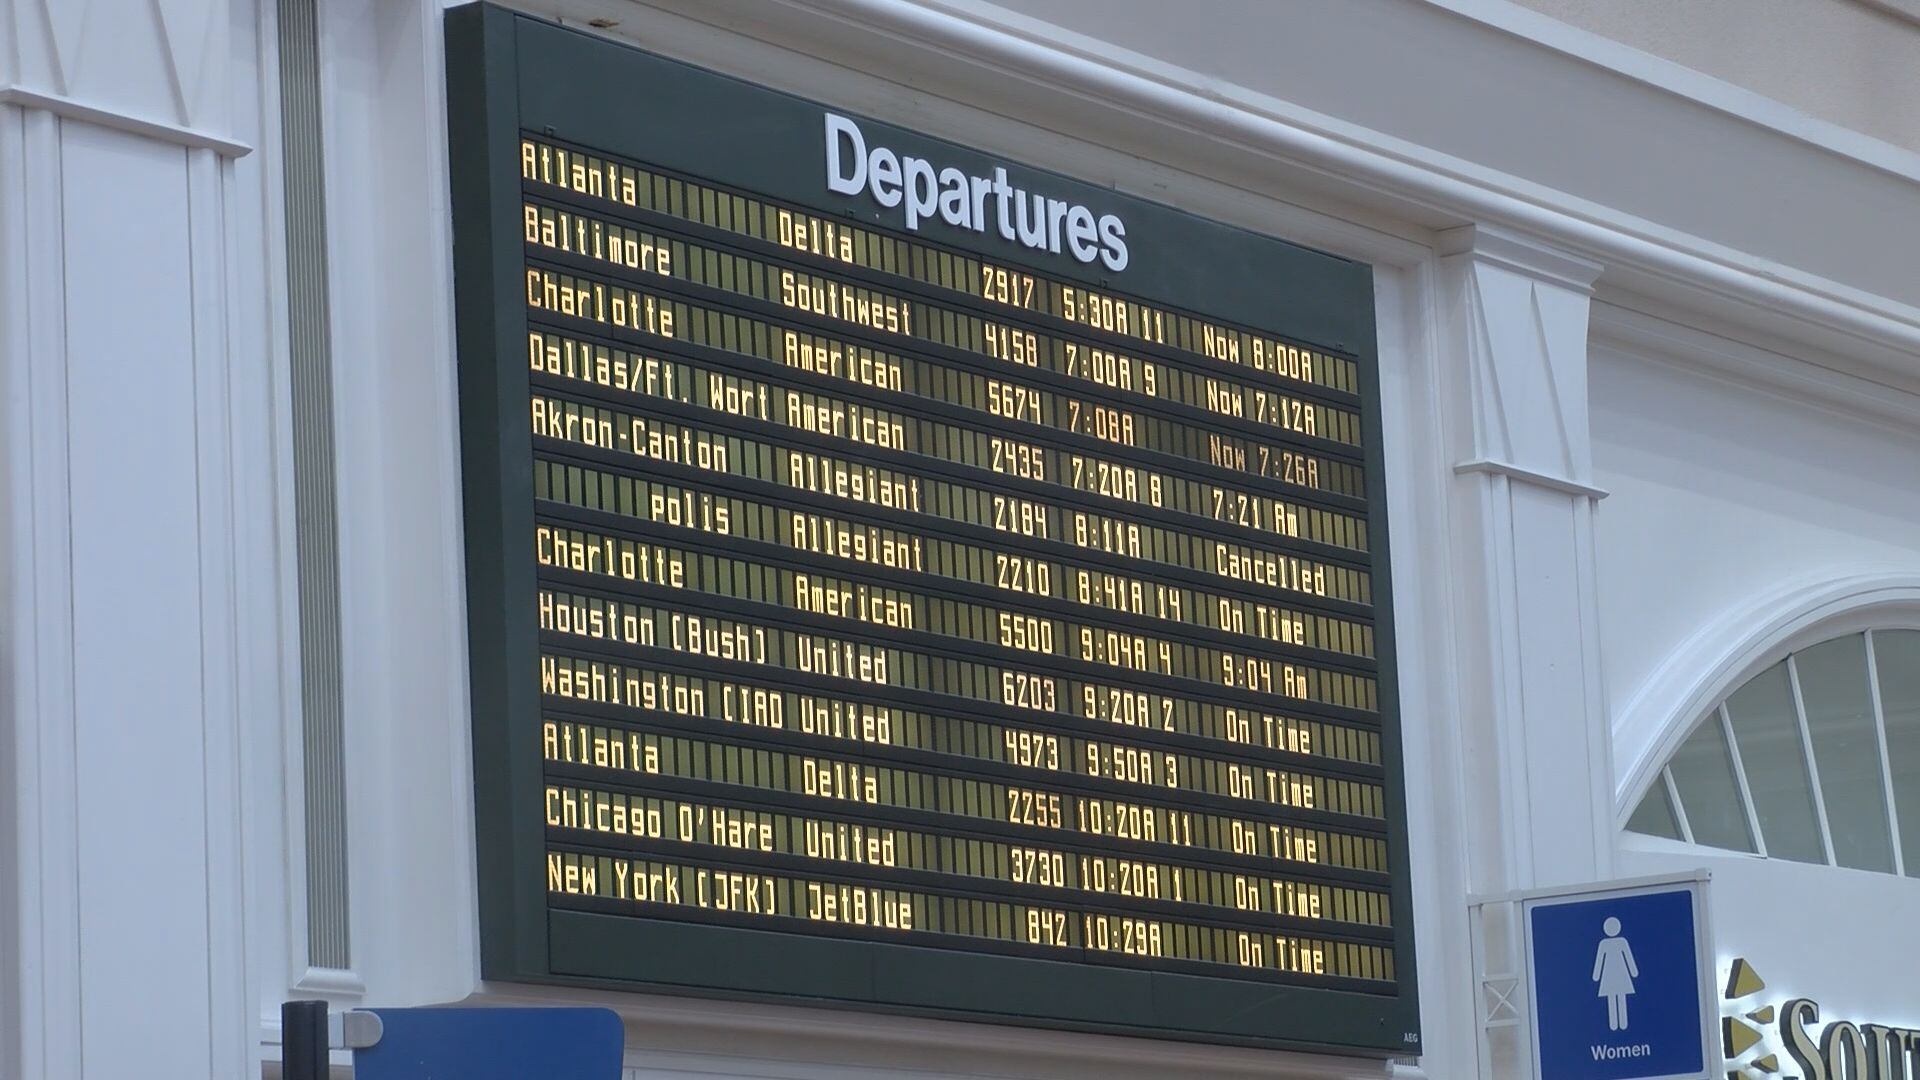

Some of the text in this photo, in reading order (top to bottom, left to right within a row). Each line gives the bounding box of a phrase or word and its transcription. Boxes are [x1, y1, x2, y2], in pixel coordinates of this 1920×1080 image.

[521, 142, 1313, 384] Atlanta Delta 2917 5:30A 11 Now 8:00A
[824, 112, 1129, 272] Departures
[524, 205, 1316, 437] Baltimore Southwest 4158 7:00A 9 Now 7:12A
[527, 269, 1318, 489] Charlotte American 5674 7:08A Now 7:26A
[529, 333, 1298, 538] Dallas/Ft. Wort American 2435 7:20A 8 7:21 Am
[531, 397, 1325, 597] Akron-Canton Allegiant 2184 8:11A Cancelled
[536, 527, 1307, 700] Charlotte American 5500 9:04A 4 9:04 Am
[650, 492, 1304, 646] polis Allegiant 2210 8:41A 14 On Time
[538, 592, 654, 647] Houston
[797, 635, 887, 685] United
[1002, 671, 1056, 713] 6203
[1083, 685, 1149, 729] 9:20A
[1162, 698, 1175, 733] 2
[1225, 709, 1250, 745] On
[1262, 715, 1311, 755] Time
[540, 656, 704, 717] Washington
[800, 697, 890, 745] United
[1004, 729, 1059, 771] 4973
[1086, 743, 1153, 785] 9:50A
[1164, 755, 1178, 789] 3
[1228, 765, 1253, 800] On
[1265, 770, 1314, 809] Time
[543, 722, 1317, 864] Atlanta Delta 2255 10:20A 11 On Time
[545, 787, 661, 839] Chicago
[805, 821, 895, 868] United
[1010, 848, 1065, 888] 3730
[1081, 857, 1159, 900] 10:20A
[1173, 868, 1182, 902] 1
[1234, 876, 1260, 912] On
[1272, 881, 1321, 919] Time
[547, 853, 596, 896] New
[614, 861, 680, 905] York
[807, 883, 912, 930] JetBlue
[1027, 909, 1067, 947] 842
[1085, 915, 1162, 958] 10:29A
[1237, 933, 1263, 968] On
[1275, 938, 1324, 975] Time
[1403, 1032, 1419, 1043] AEG
[1590, 1043, 1651, 1061] Women
